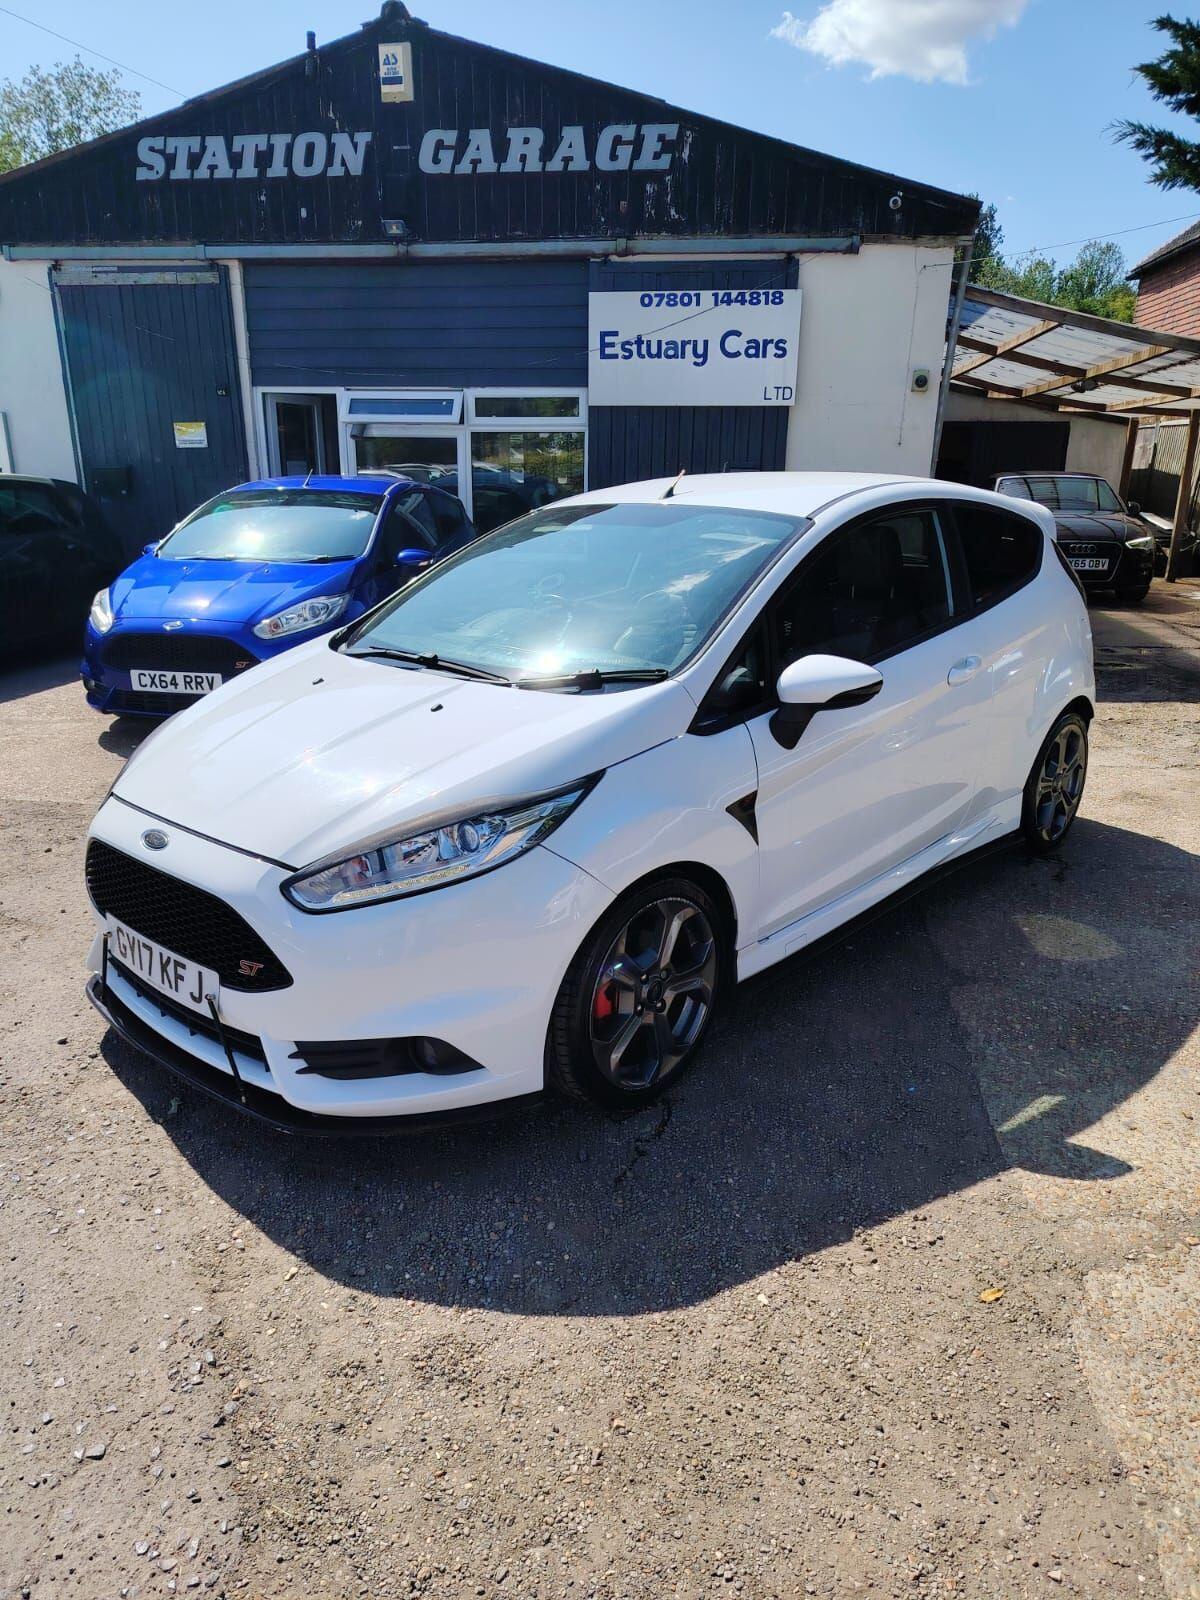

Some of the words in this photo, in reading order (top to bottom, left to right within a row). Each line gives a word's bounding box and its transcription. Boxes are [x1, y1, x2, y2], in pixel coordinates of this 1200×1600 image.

[136, 132, 372, 181] STATION
[418, 124, 680, 174] GARAGE
[640, 292, 700, 307] 07801
[712, 290, 784, 306] 144818
[600, 330, 709, 367] Estuary
[720, 330, 788, 359] Cars
[763, 386, 793, 400] LTD
[234, 661, 249, 669] ST
[138, 672, 179, 690] CX64
[183, 674, 215, 691] RRV
[116, 925, 153, 976] GY17
[238, 960, 265, 976] ST
